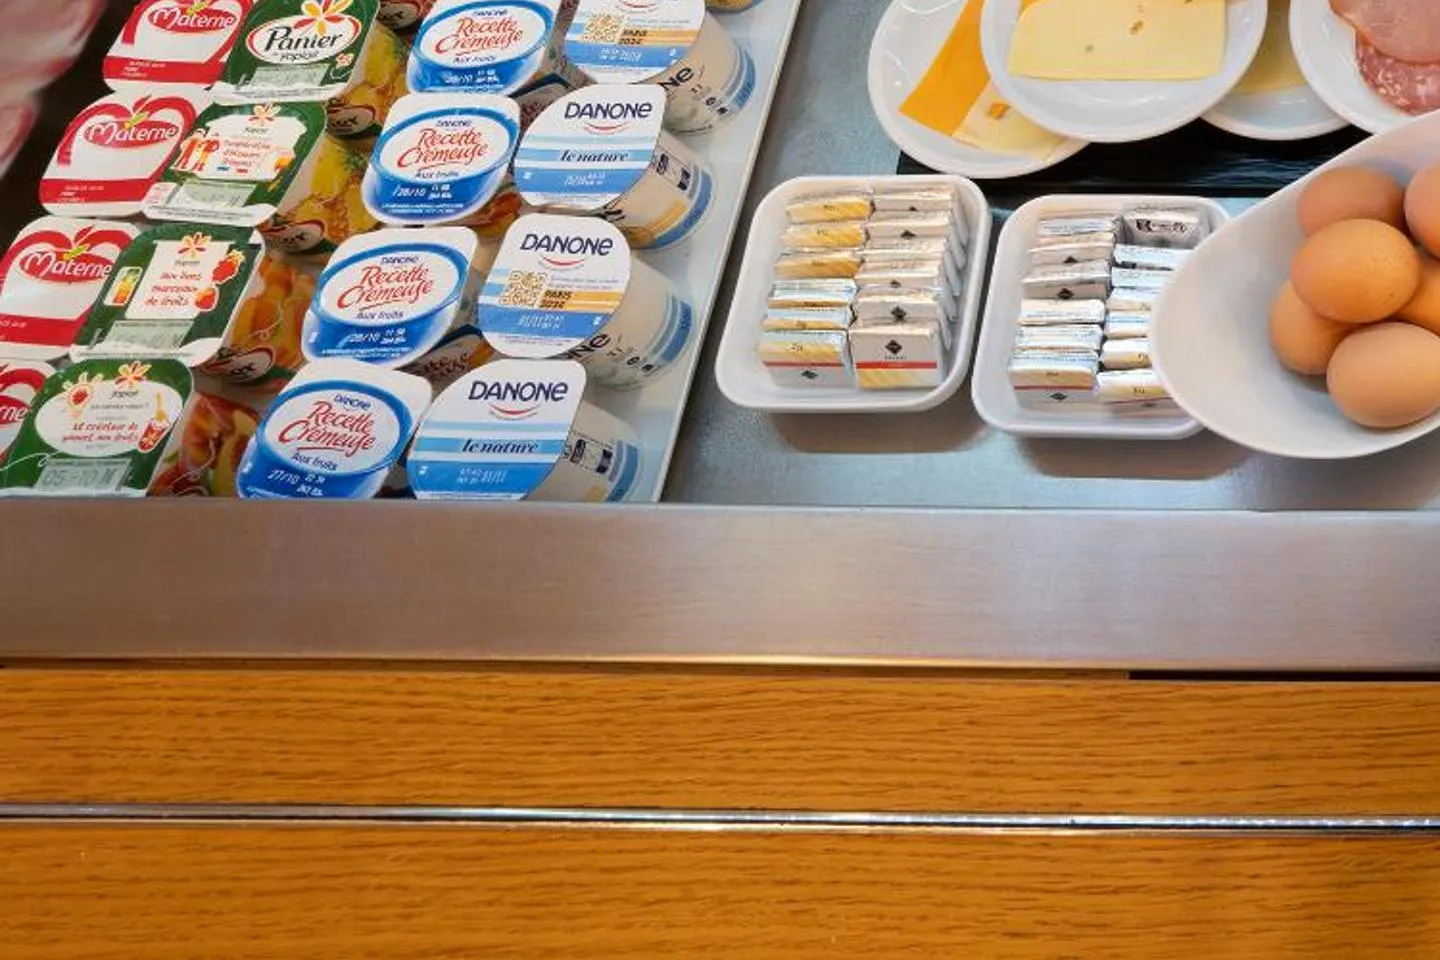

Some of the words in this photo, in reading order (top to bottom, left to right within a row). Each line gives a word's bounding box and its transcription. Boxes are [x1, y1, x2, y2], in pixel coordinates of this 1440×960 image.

[153, 8, 238, 30] Materne
[455, 16, 517, 36] Recette
[264, 25, 342, 51] Panier
[88, 122, 181, 144] Materne
[417, 127, 482, 149] Recette
[25, 251, 113, 279] Materne
[359, 264, 429, 286] Recette
[308, 400, 375, 435] Recette
